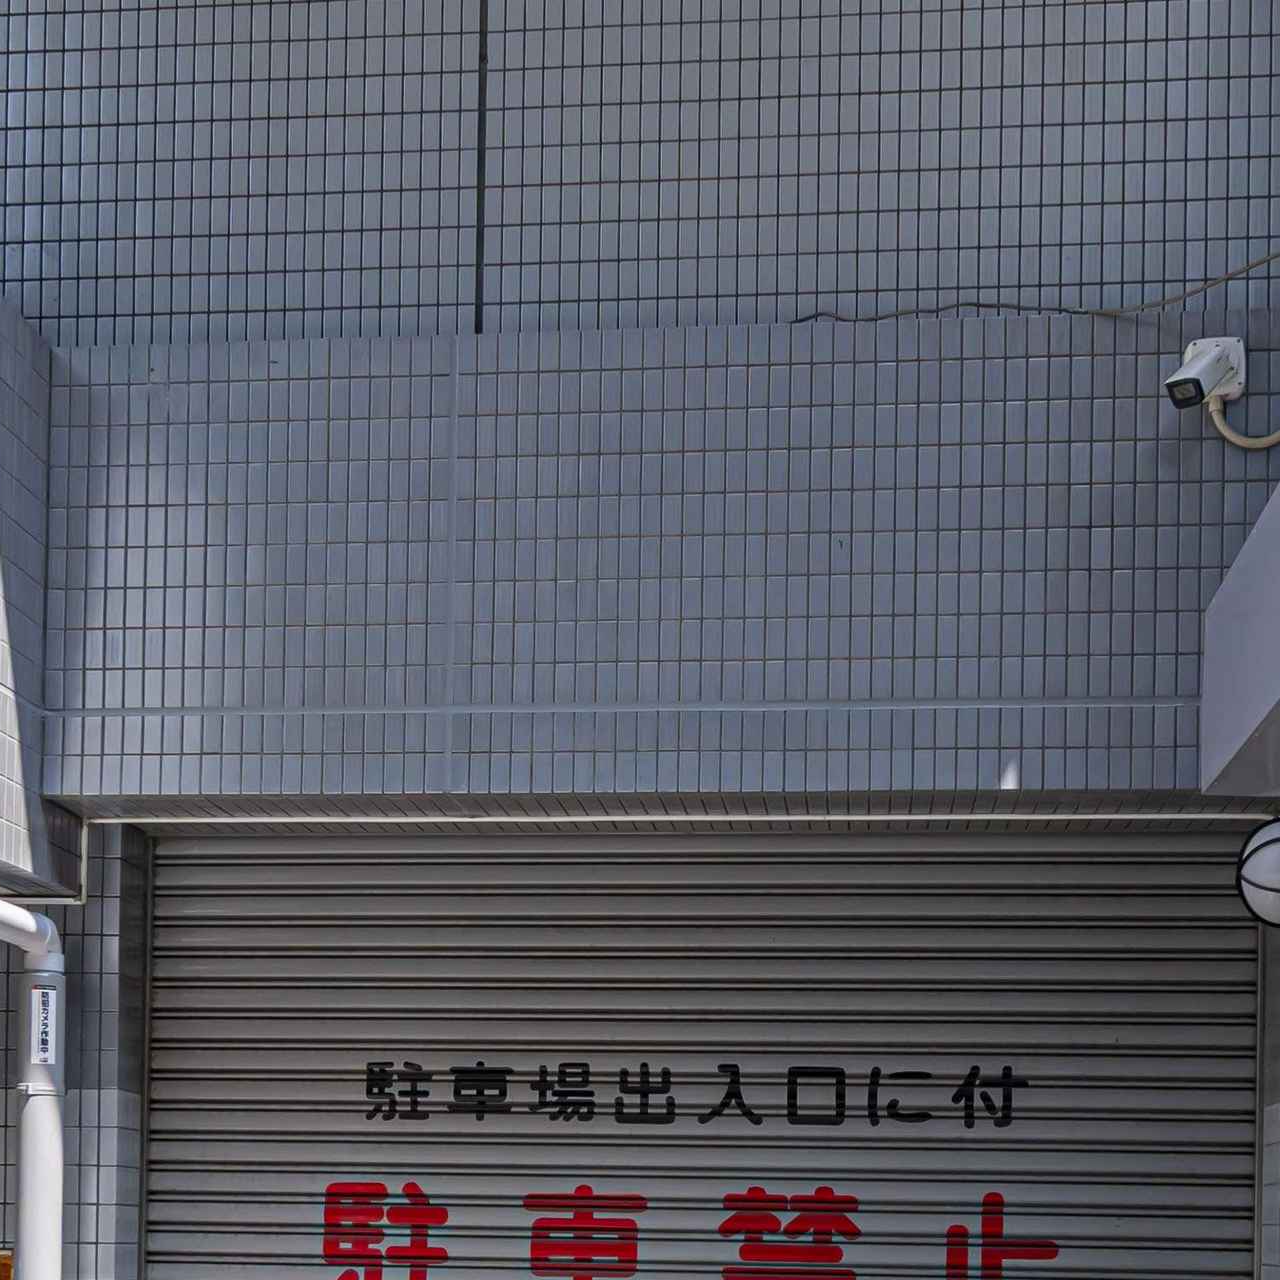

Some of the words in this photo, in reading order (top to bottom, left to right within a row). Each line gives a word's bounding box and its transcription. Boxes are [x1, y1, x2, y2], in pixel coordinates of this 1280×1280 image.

[365, 1061, 1029, 1129] 駐車場出入口に付
